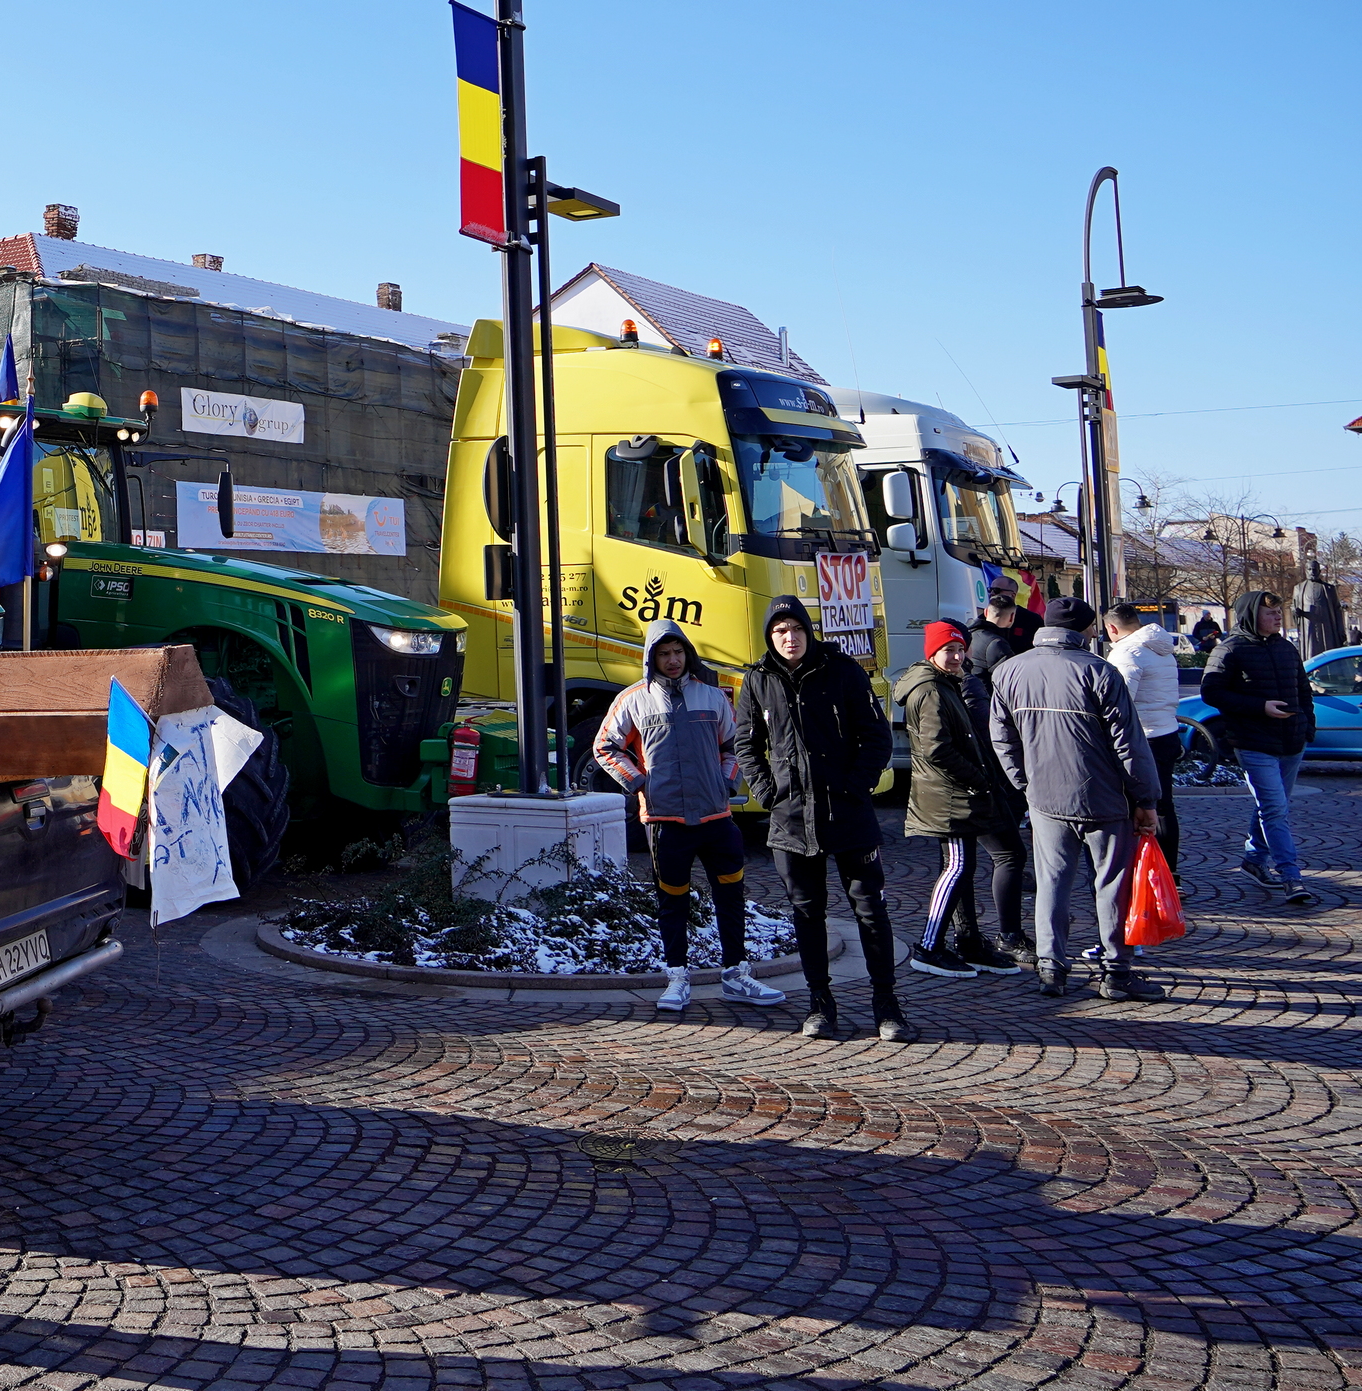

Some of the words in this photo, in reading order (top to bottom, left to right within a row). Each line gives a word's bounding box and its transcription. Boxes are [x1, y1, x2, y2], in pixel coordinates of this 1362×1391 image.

[192, 394, 238, 426] Glory
[258, 419, 289, 434] grup
[257, 496, 280, 504] GRECIA
[283, 497, 299, 506] EGIPT
[279, 510, 295, 518] EURO
[389, 516, 400, 526] TUI
[89, 561, 113, 573] JOHN
[113, 562, 143, 575] DEERE
[569, 572, 587, 582] 277
[820, 555, 867, 602] STOP
[107, 580, 130, 592] IPSO
[308, 607, 335, 622] 8320
[336, 614, 345, 625] R
[822, 603, 869, 628] TRANZIT
[824, 633, 872, 657] RAINA
